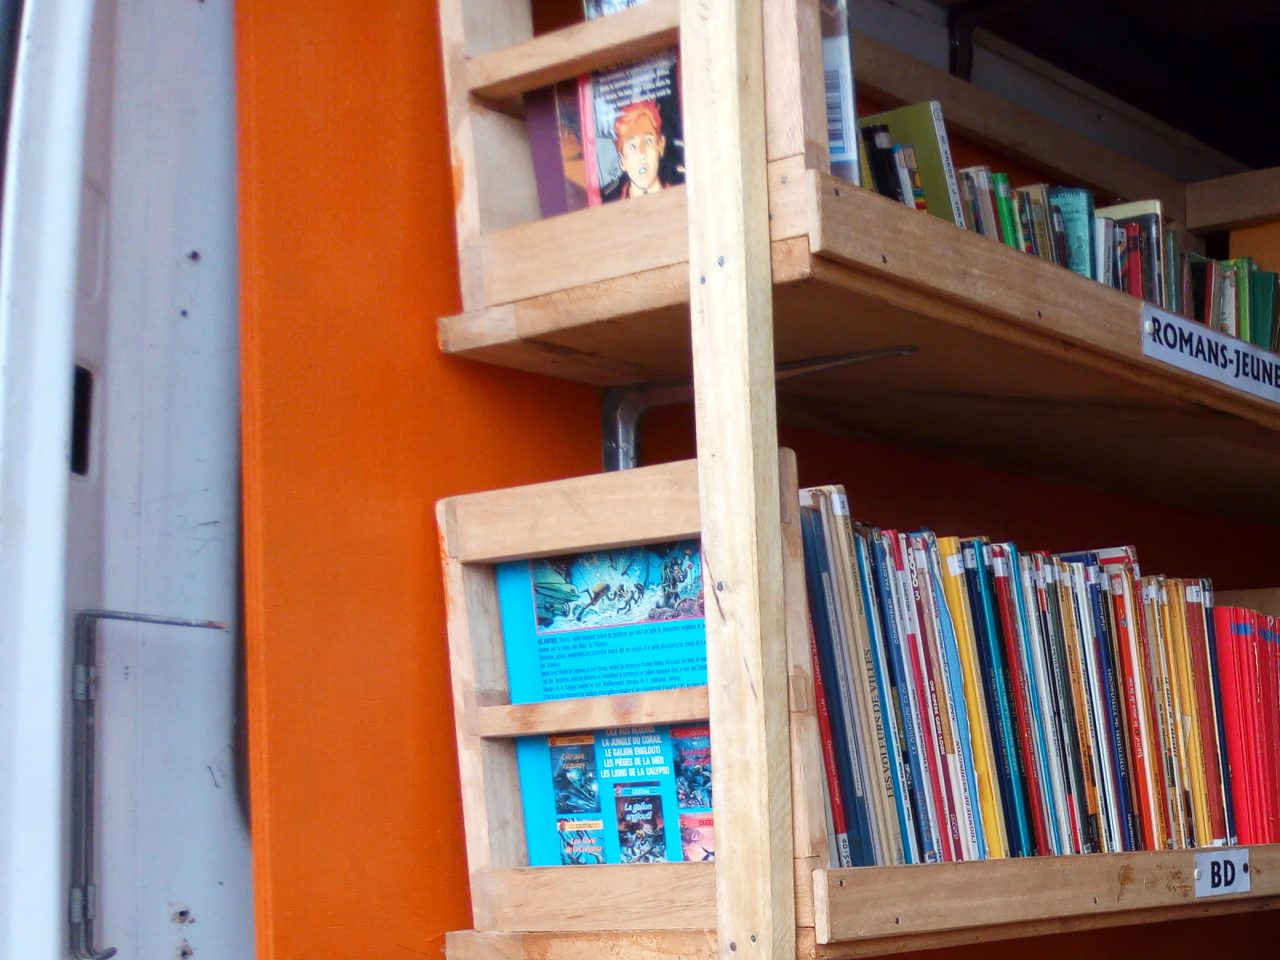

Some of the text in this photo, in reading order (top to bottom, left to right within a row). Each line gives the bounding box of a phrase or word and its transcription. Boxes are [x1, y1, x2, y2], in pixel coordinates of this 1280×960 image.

[863, 648, 877, 692] VILLES
[870, 693, 880, 710] DE
[873, 711, 890, 773] VOLEURS
[601, 770, 610, 778] LES
[629, 769, 637, 777] DE
[638, 768, 645, 776] LA
[646, 766, 669, 776] CALYPSO
[642, 757, 651, 765] LA
[651, 756, 664, 764] MER
[955, 739, 968, 793] WASHINGTON
[1211, 858, 1235, 889] BD
